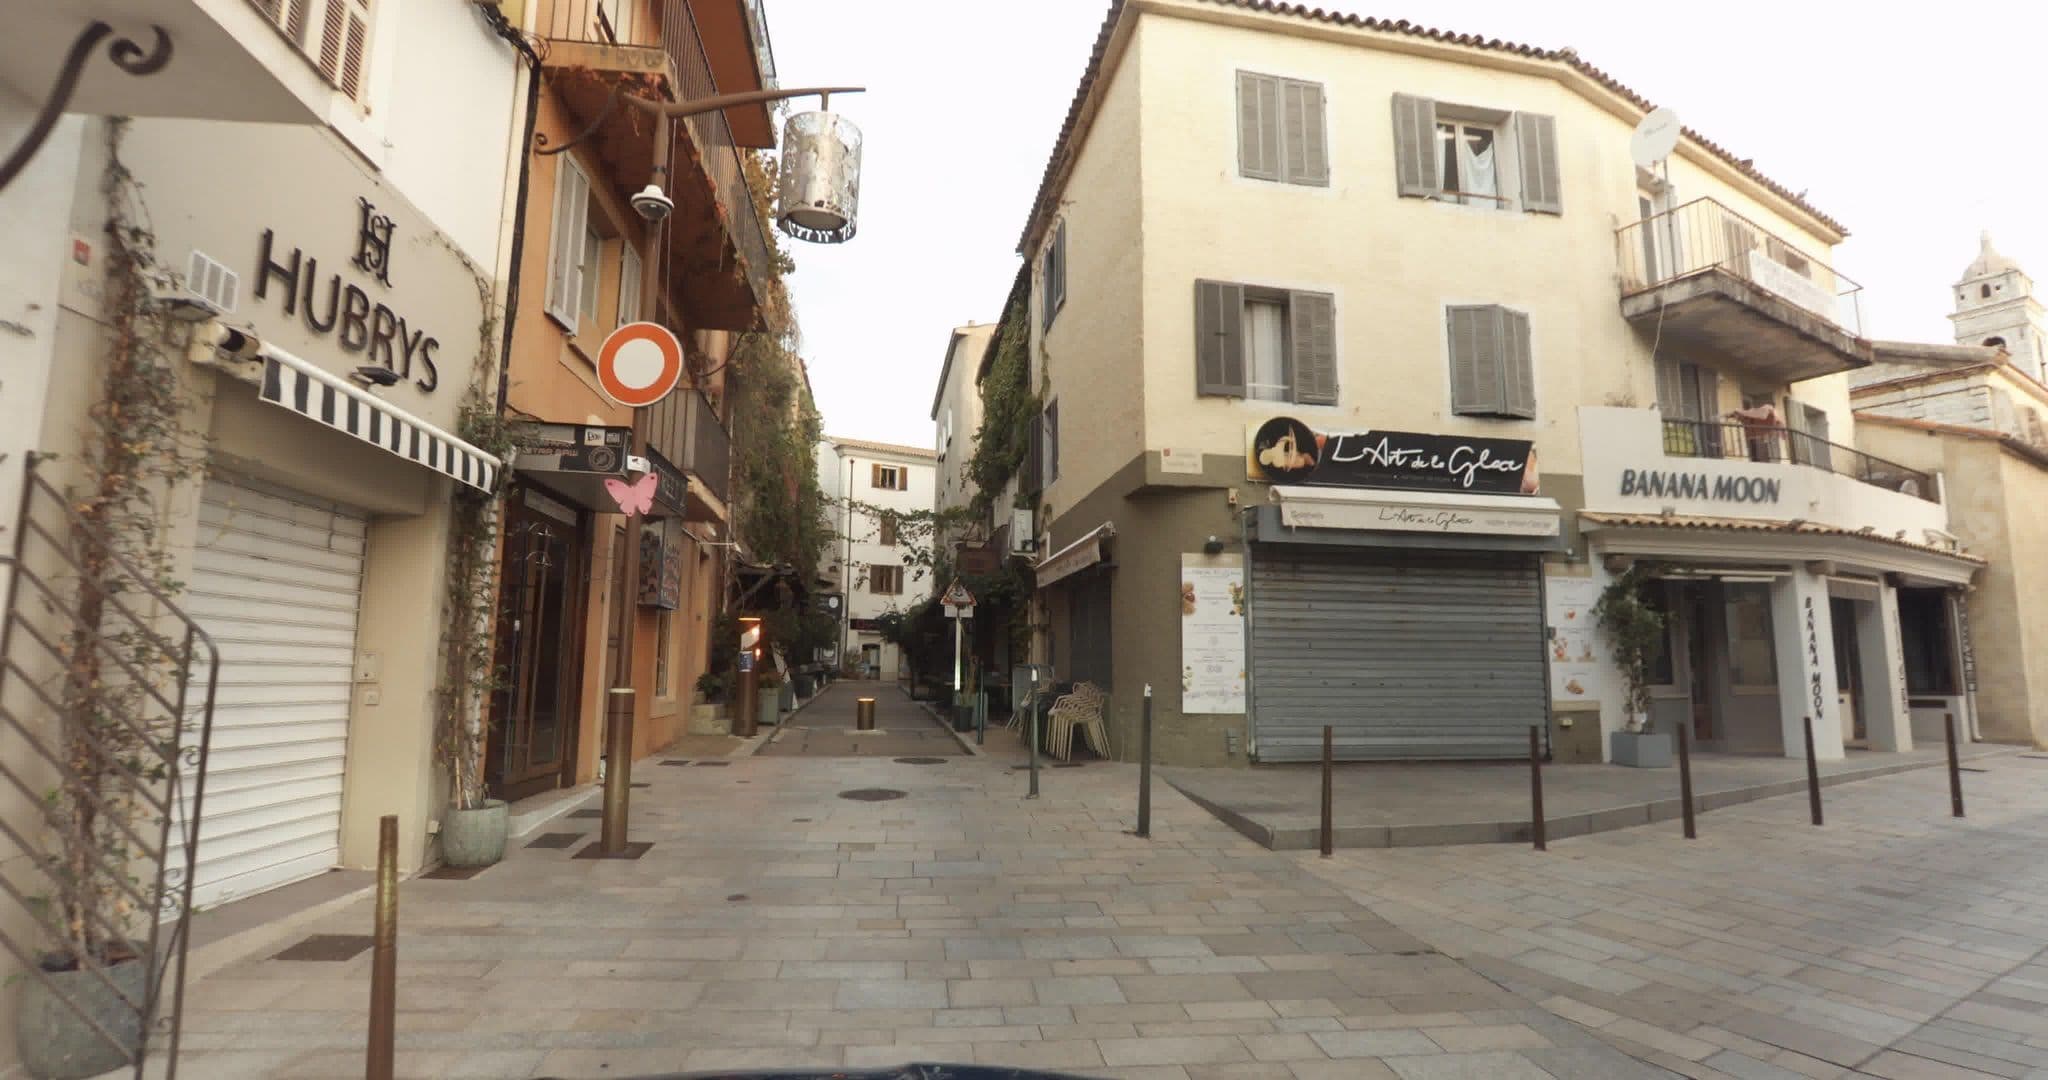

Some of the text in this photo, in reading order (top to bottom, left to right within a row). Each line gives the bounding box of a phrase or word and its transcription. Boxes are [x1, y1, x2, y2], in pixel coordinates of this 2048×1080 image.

[254, 228, 440, 392] HUBRYS
[1410, 456, 1430, 469] de
[1449, 445, 1523, 487] Glace
[1620, 468, 1782, 504] BANANA MOON
[1804, 596, 1823, 719] BANANA MOON
